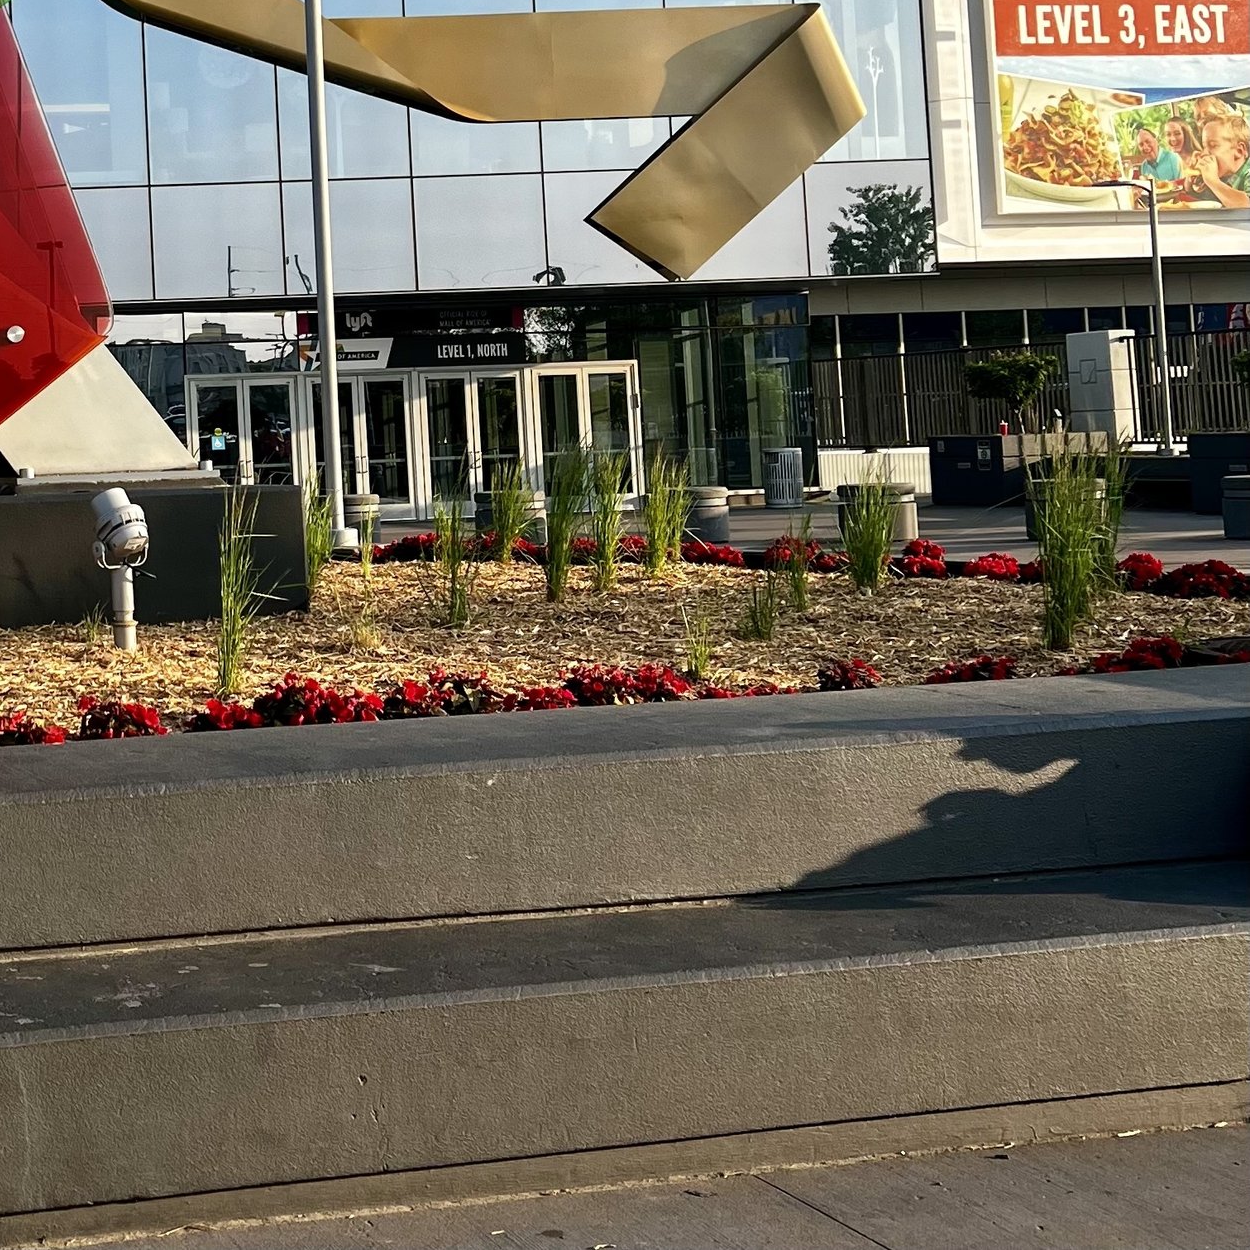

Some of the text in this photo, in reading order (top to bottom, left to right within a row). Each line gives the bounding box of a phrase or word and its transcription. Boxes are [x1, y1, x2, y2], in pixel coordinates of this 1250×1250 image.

[1017, 3, 1229, 50] LEVEL 3, EAST
[347, 352, 376, 360] AMERICA
[437, 343, 509, 359] LEVEL 1, NORTH
